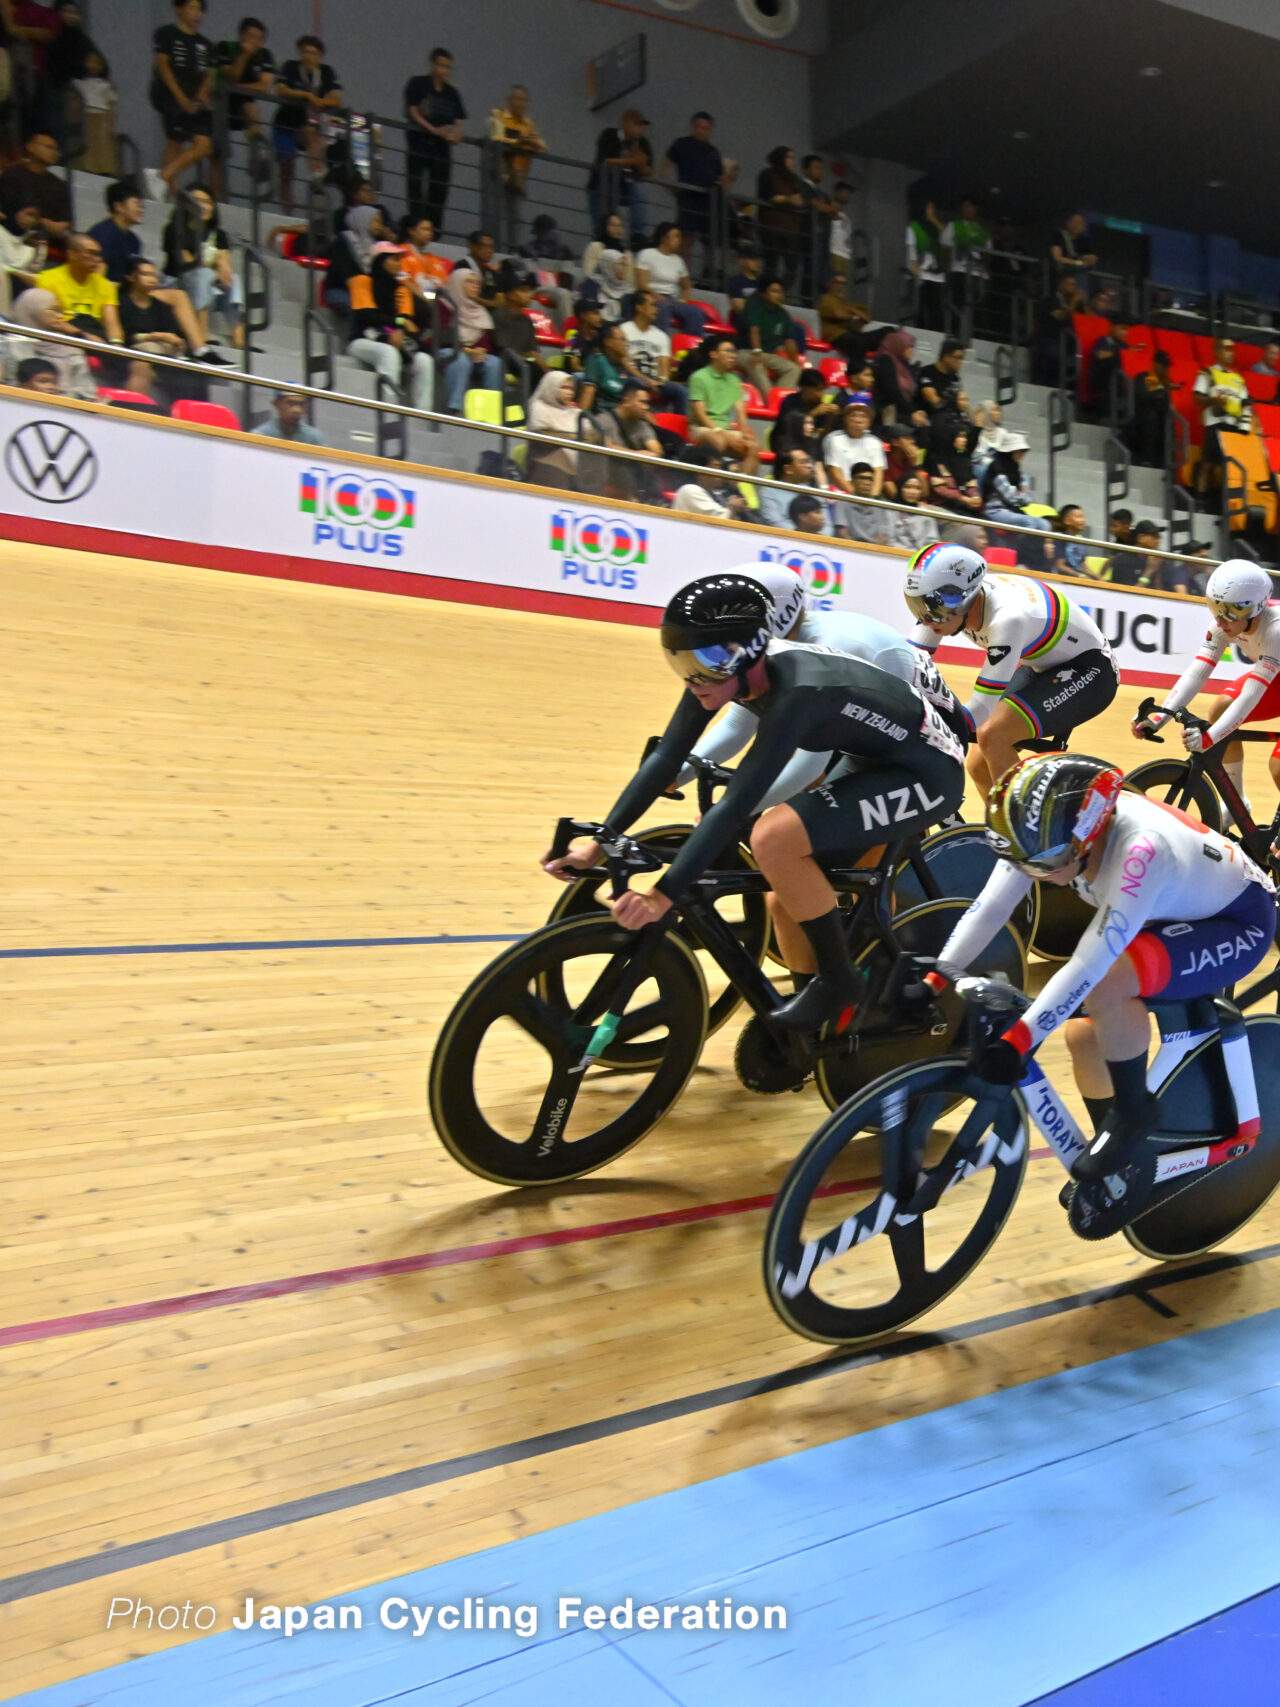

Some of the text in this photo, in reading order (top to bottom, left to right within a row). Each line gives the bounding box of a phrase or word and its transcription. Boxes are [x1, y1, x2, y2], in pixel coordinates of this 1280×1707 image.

[307, 467, 405, 529] 100
[314, 523, 404, 557] PLUS
[556, 509, 642, 567] 100
[562, 560, 638, 590] PLUS
[1096, 606, 1172, 655] UCI
[840, 702, 866, 721] NEW
[864, 710, 910, 742] ZEALAND
[858, 782, 945, 831] NZL
[1180, 925, 1266, 976] JAPAN
[537, 1096, 568, 1159] Velobike
[1162, 1157, 1205, 1175] JAPAN
